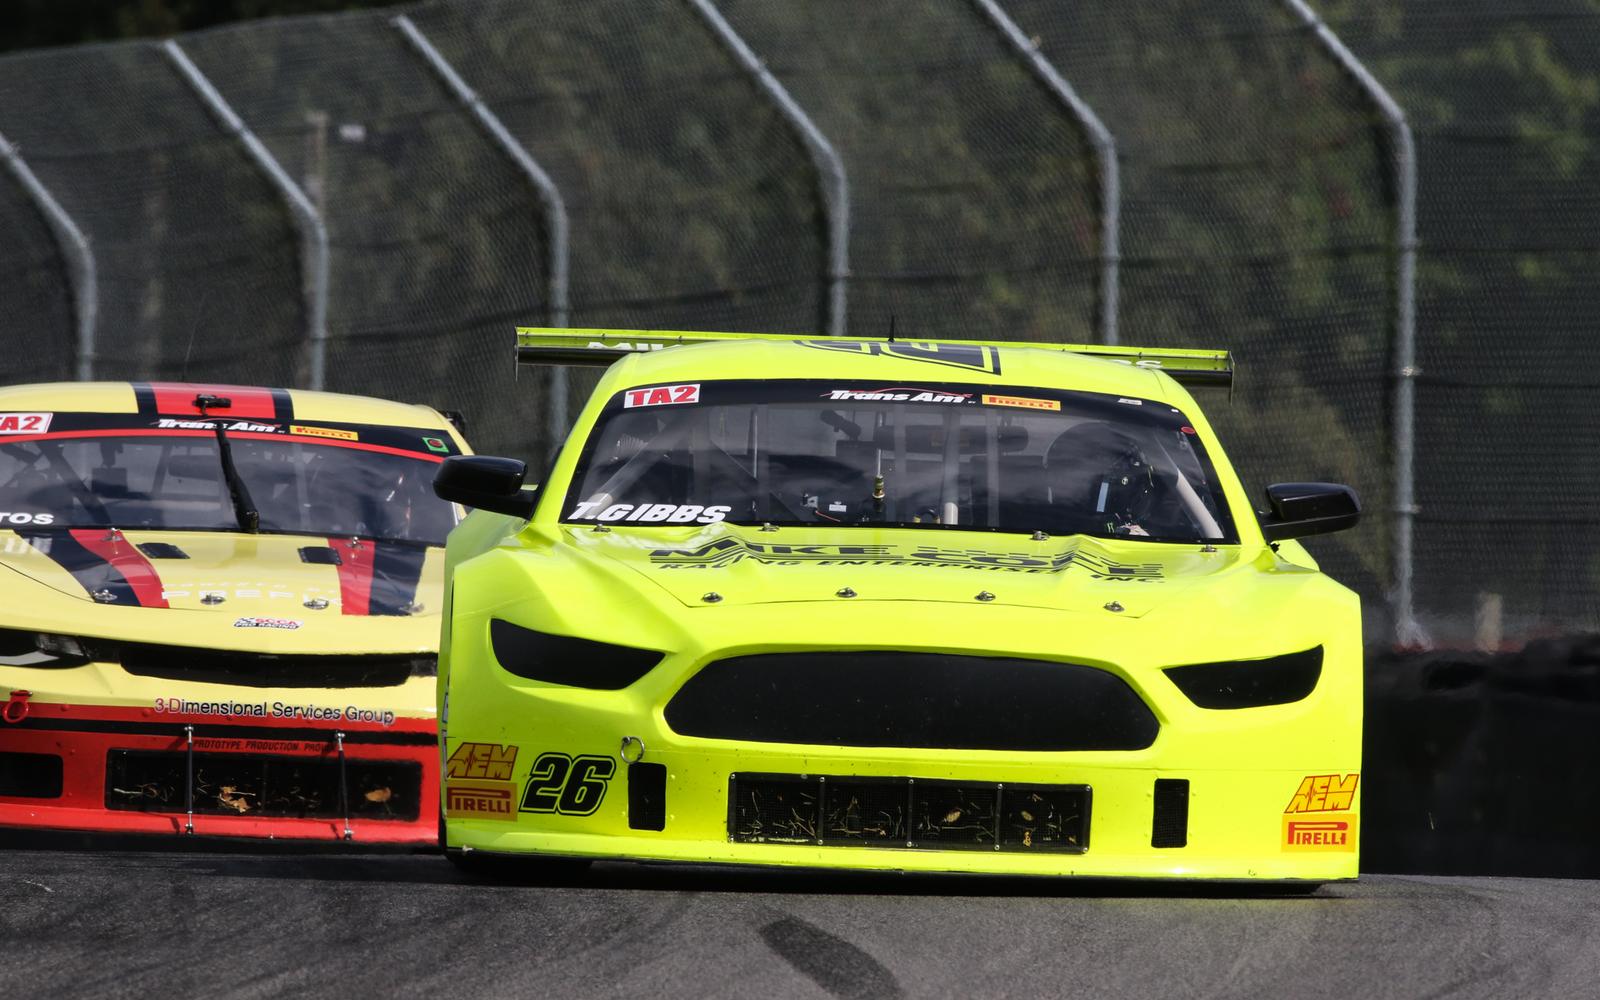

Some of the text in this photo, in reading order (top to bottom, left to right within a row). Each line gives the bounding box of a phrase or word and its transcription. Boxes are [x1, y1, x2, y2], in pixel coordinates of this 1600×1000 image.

[629, 386, 697, 406] TA2
[830, 390, 908, 401] Trans
[911, 392, 965, 403] Am
[228, 421, 276, 433] Am
[567, 501, 732, 523] T.GIBBS
[154, 697, 395, 725] 3-Dimensional Services Group
[518, 751, 617, 817] 26
[1284, 774, 1360, 813] AEM
[447, 787, 511, 814] PIRELLI
[1288, 821, 1349, 845] PIRELLI
